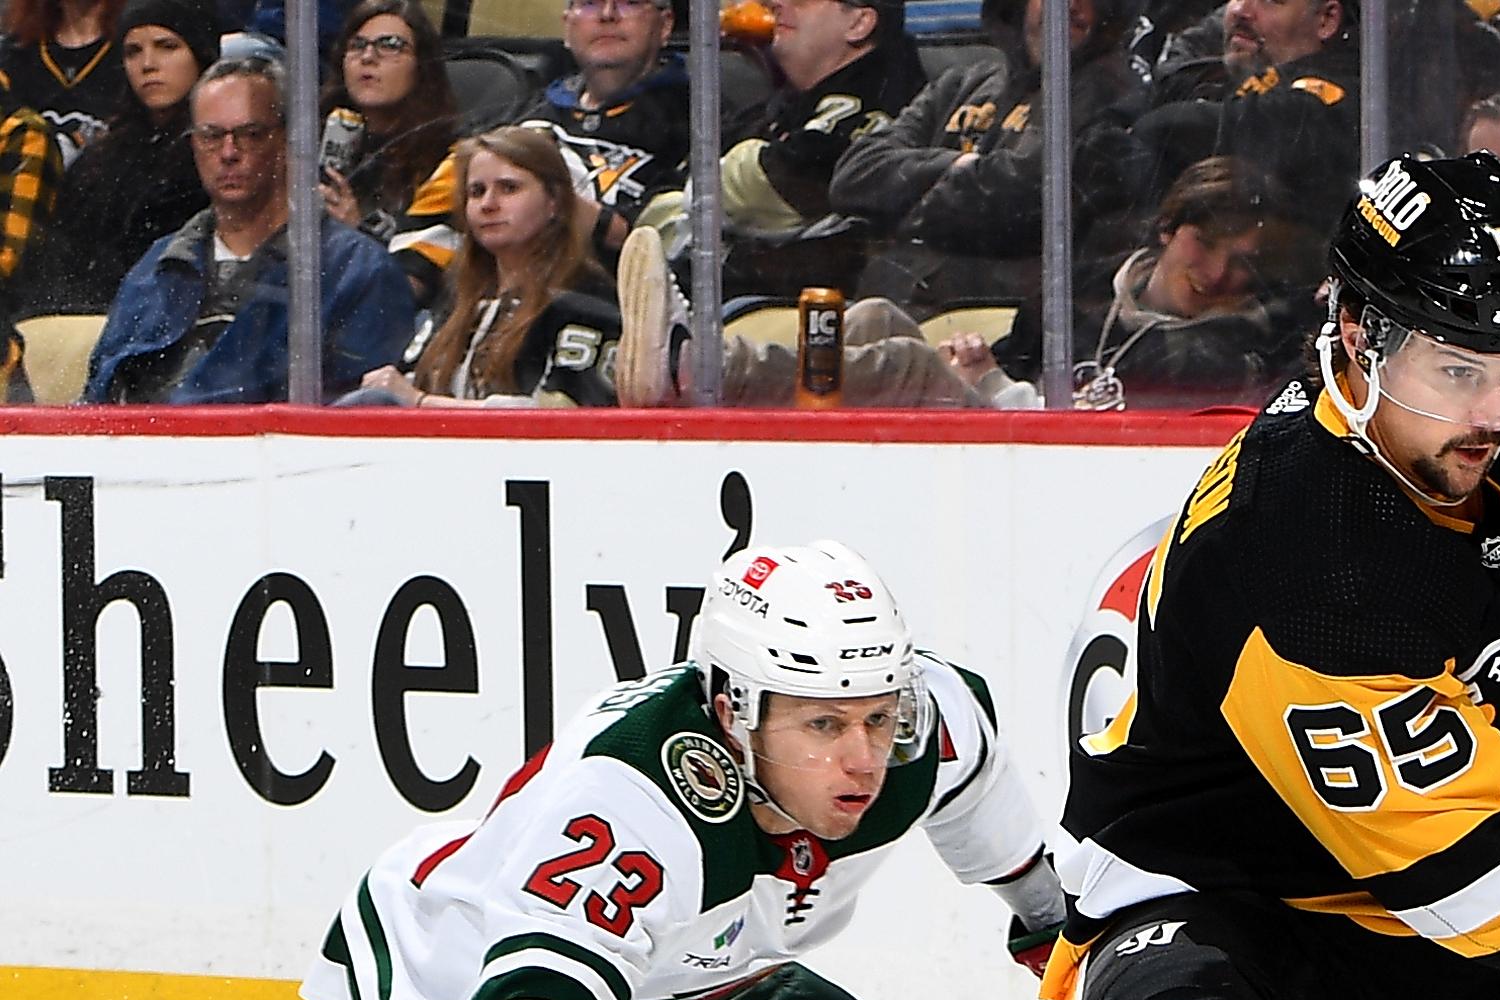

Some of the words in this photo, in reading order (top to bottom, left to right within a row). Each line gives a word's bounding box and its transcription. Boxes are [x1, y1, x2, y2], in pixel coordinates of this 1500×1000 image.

[1356, 194, 1402, 248] PENGUIN
[839, 643, 895, 660] CCM
[1282, 684, 1479, 813] 65
[521, 813, 665, 939] 23
